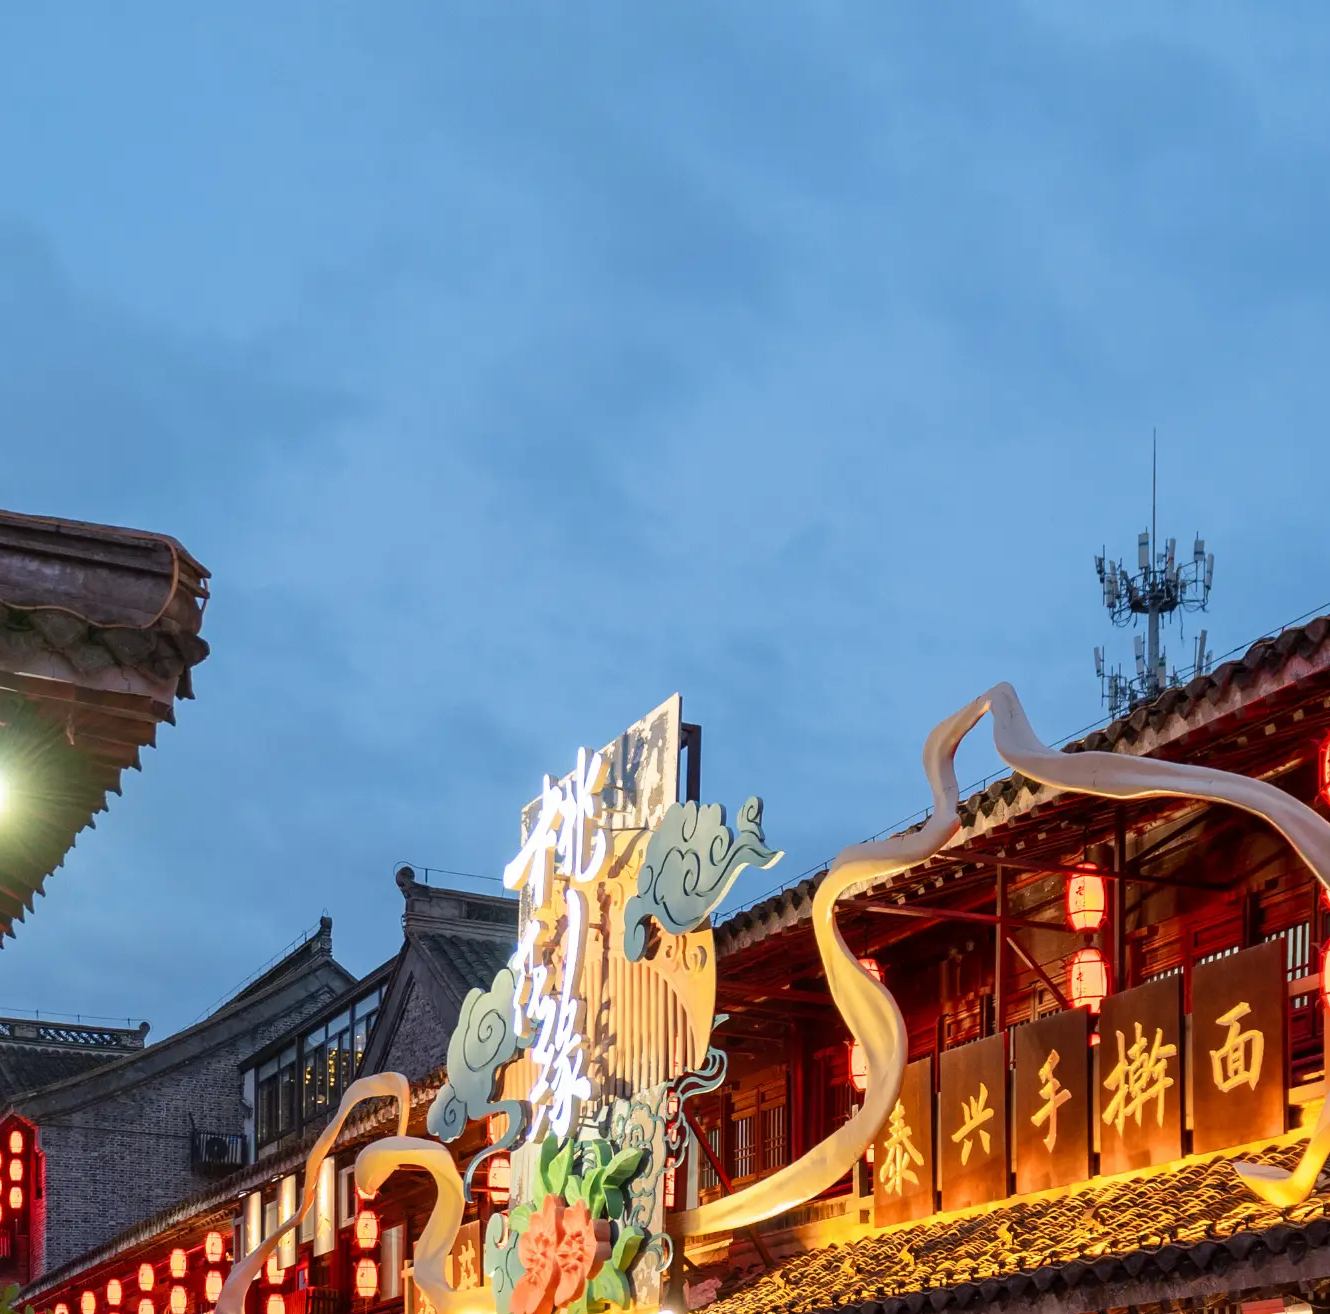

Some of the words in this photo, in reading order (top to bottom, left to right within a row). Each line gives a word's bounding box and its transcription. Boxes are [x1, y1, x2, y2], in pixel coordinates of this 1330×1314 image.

[879, 1000, 1265, 1197] 泰兴手擀面
